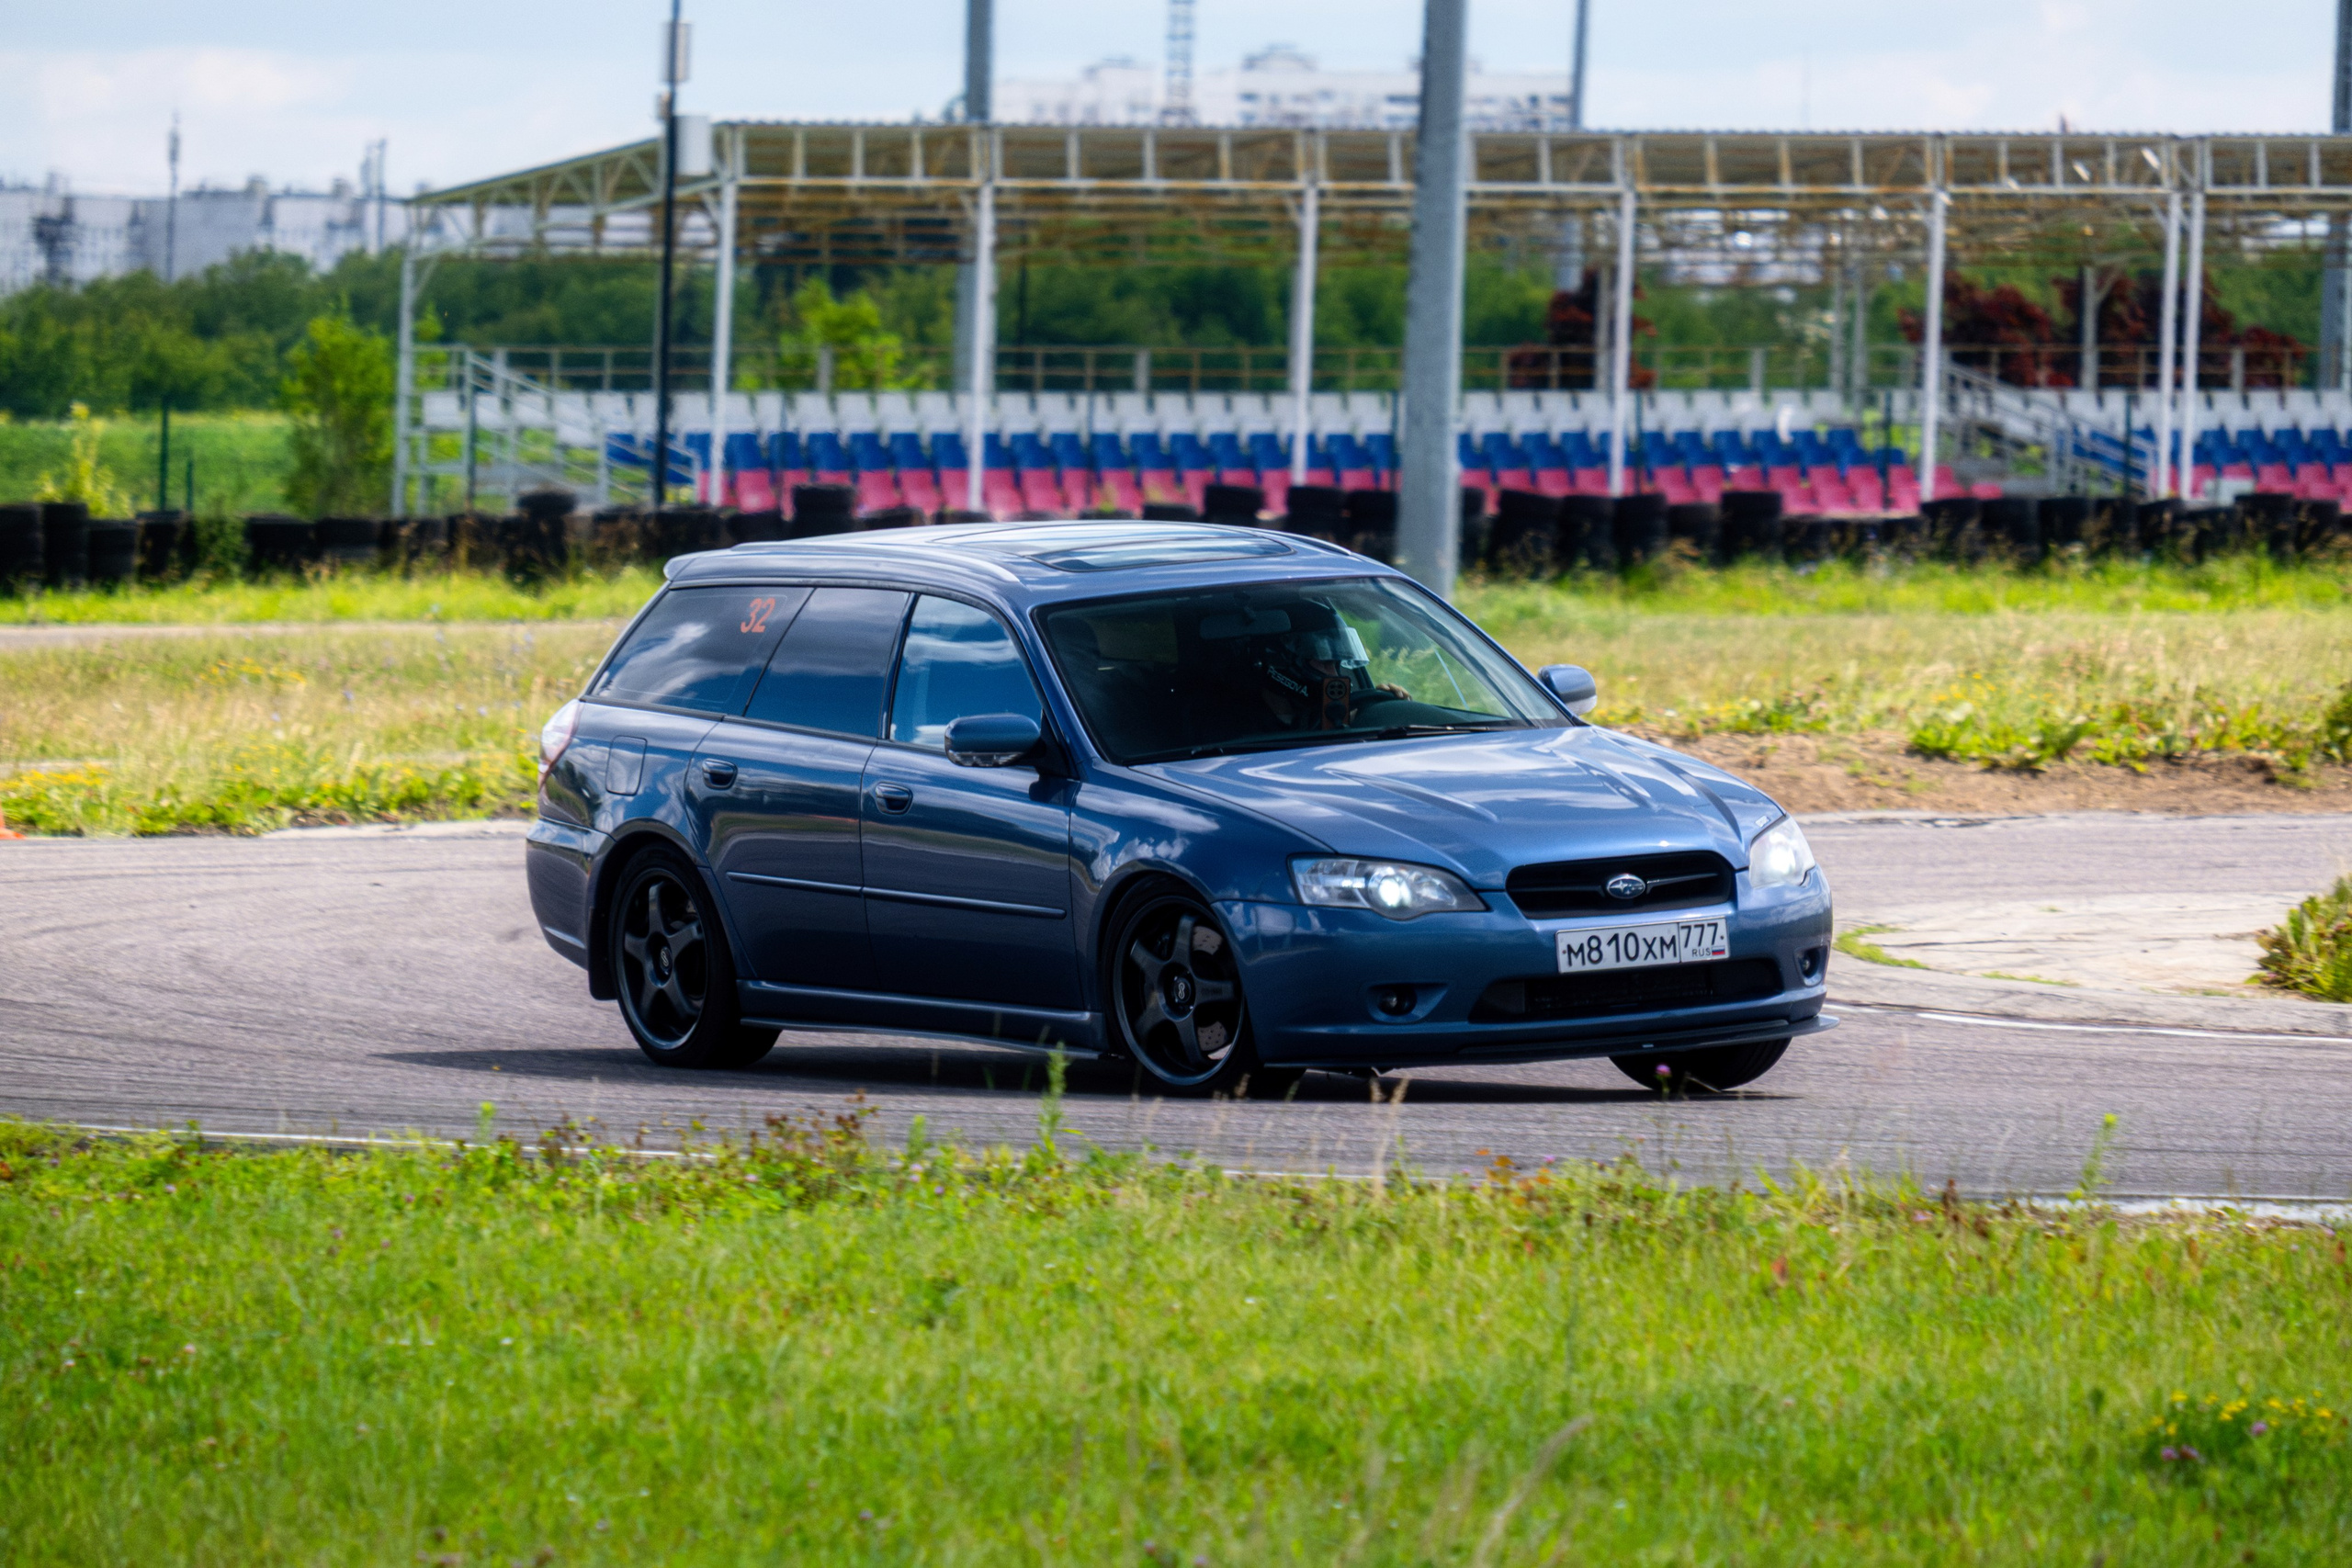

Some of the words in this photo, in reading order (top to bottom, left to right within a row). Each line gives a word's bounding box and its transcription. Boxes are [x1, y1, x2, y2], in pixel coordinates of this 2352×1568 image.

[741, 597, 776, 634] 32
[1680, 922, 1719, 949] 777
[1691, 947, 1712, 957] RUS
